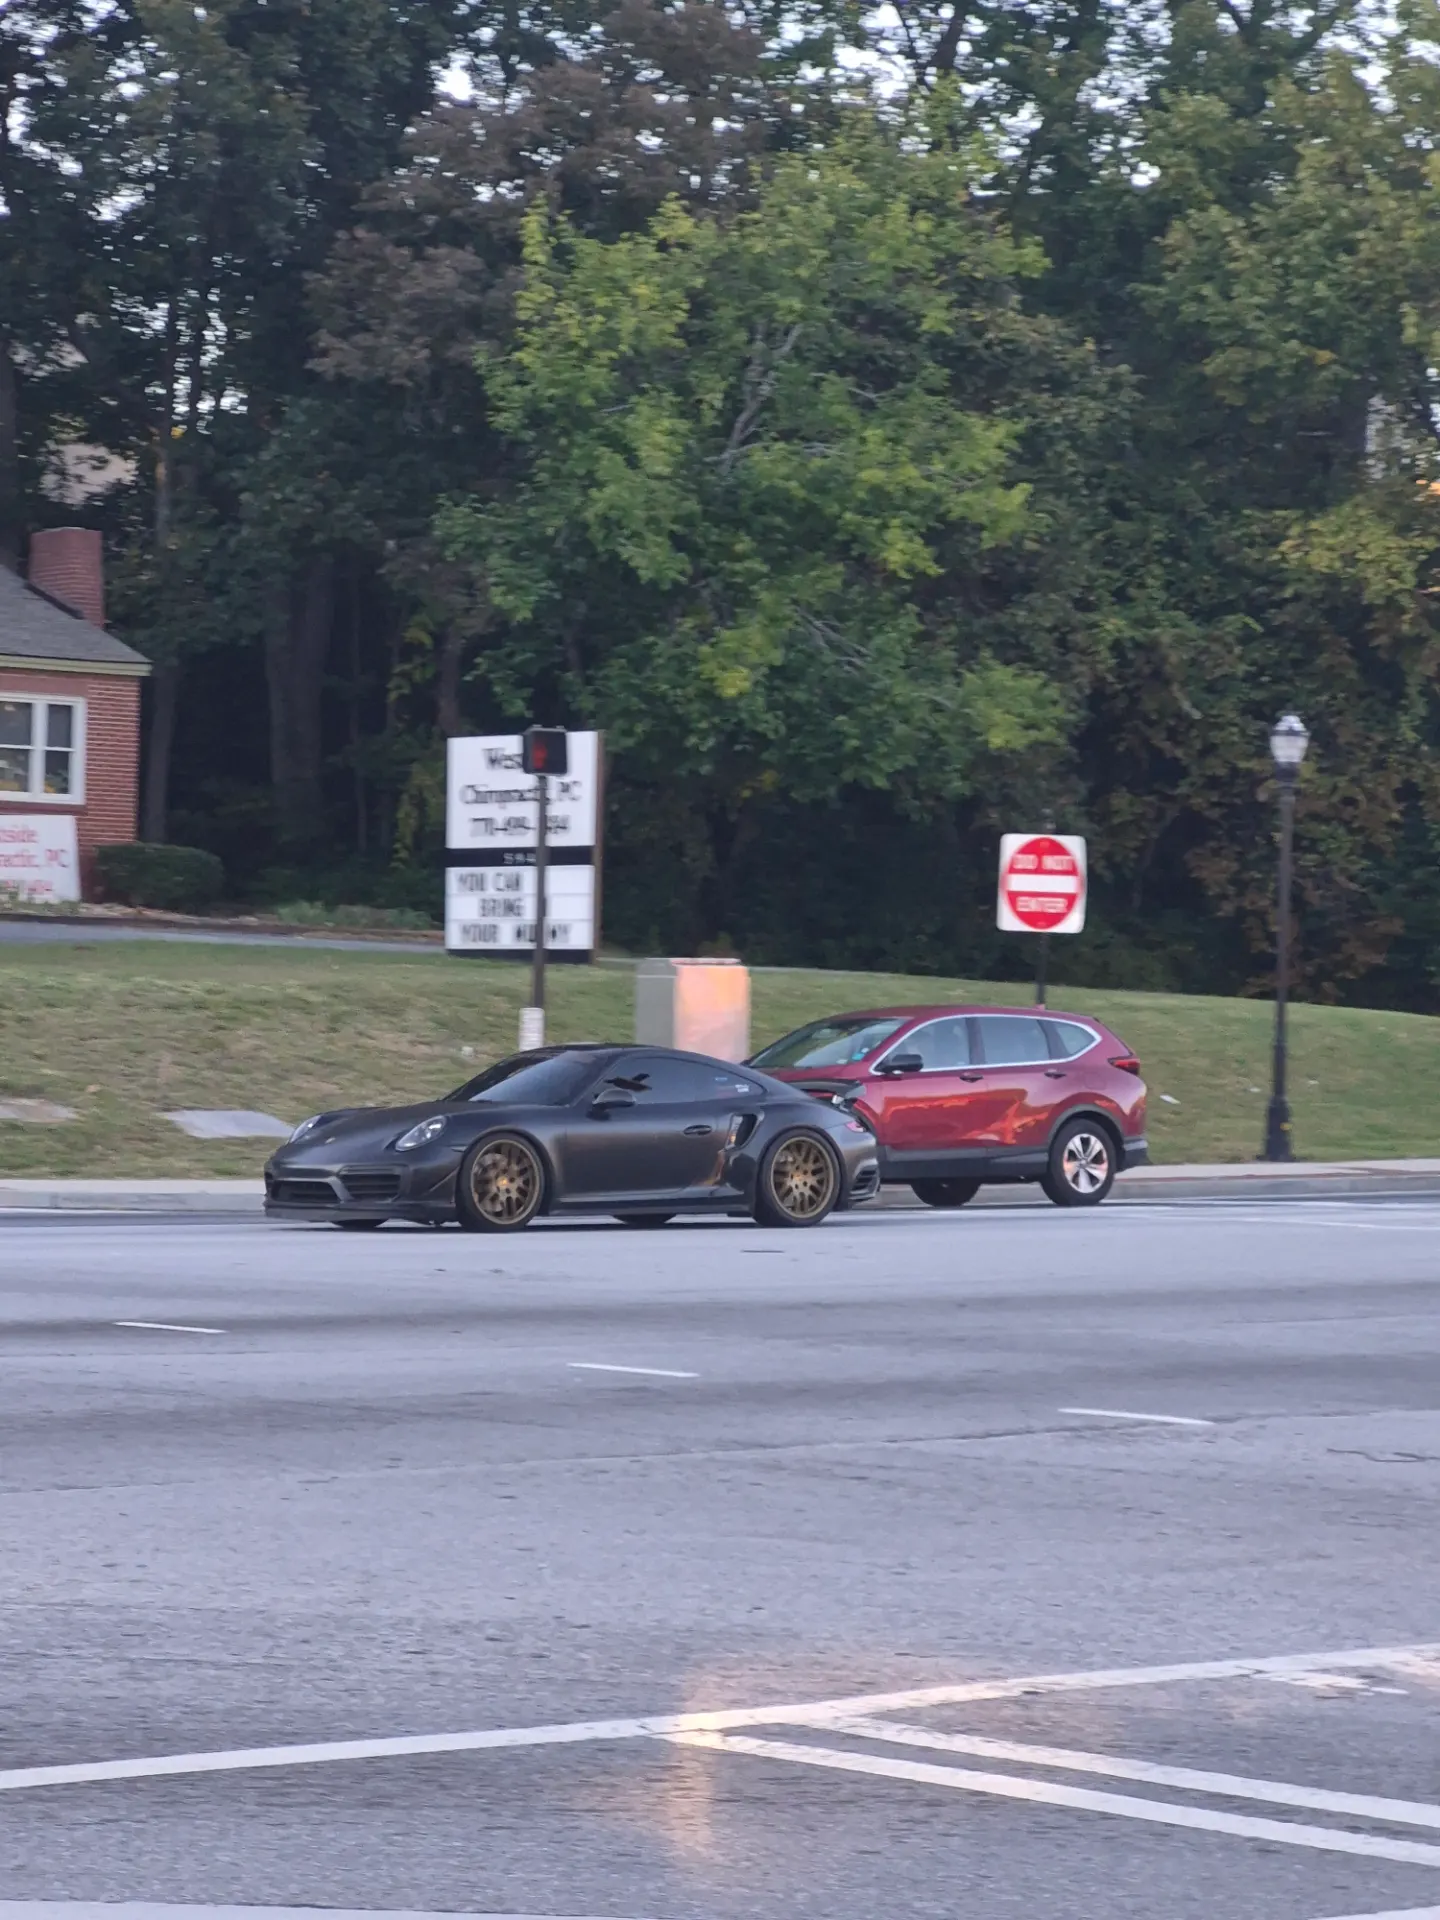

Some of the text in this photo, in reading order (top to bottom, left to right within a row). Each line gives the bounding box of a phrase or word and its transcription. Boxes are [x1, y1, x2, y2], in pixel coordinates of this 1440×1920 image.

[1012, 853, 1073, 871] DO NOT
[1015, 896, 1068, 914] ENTER
